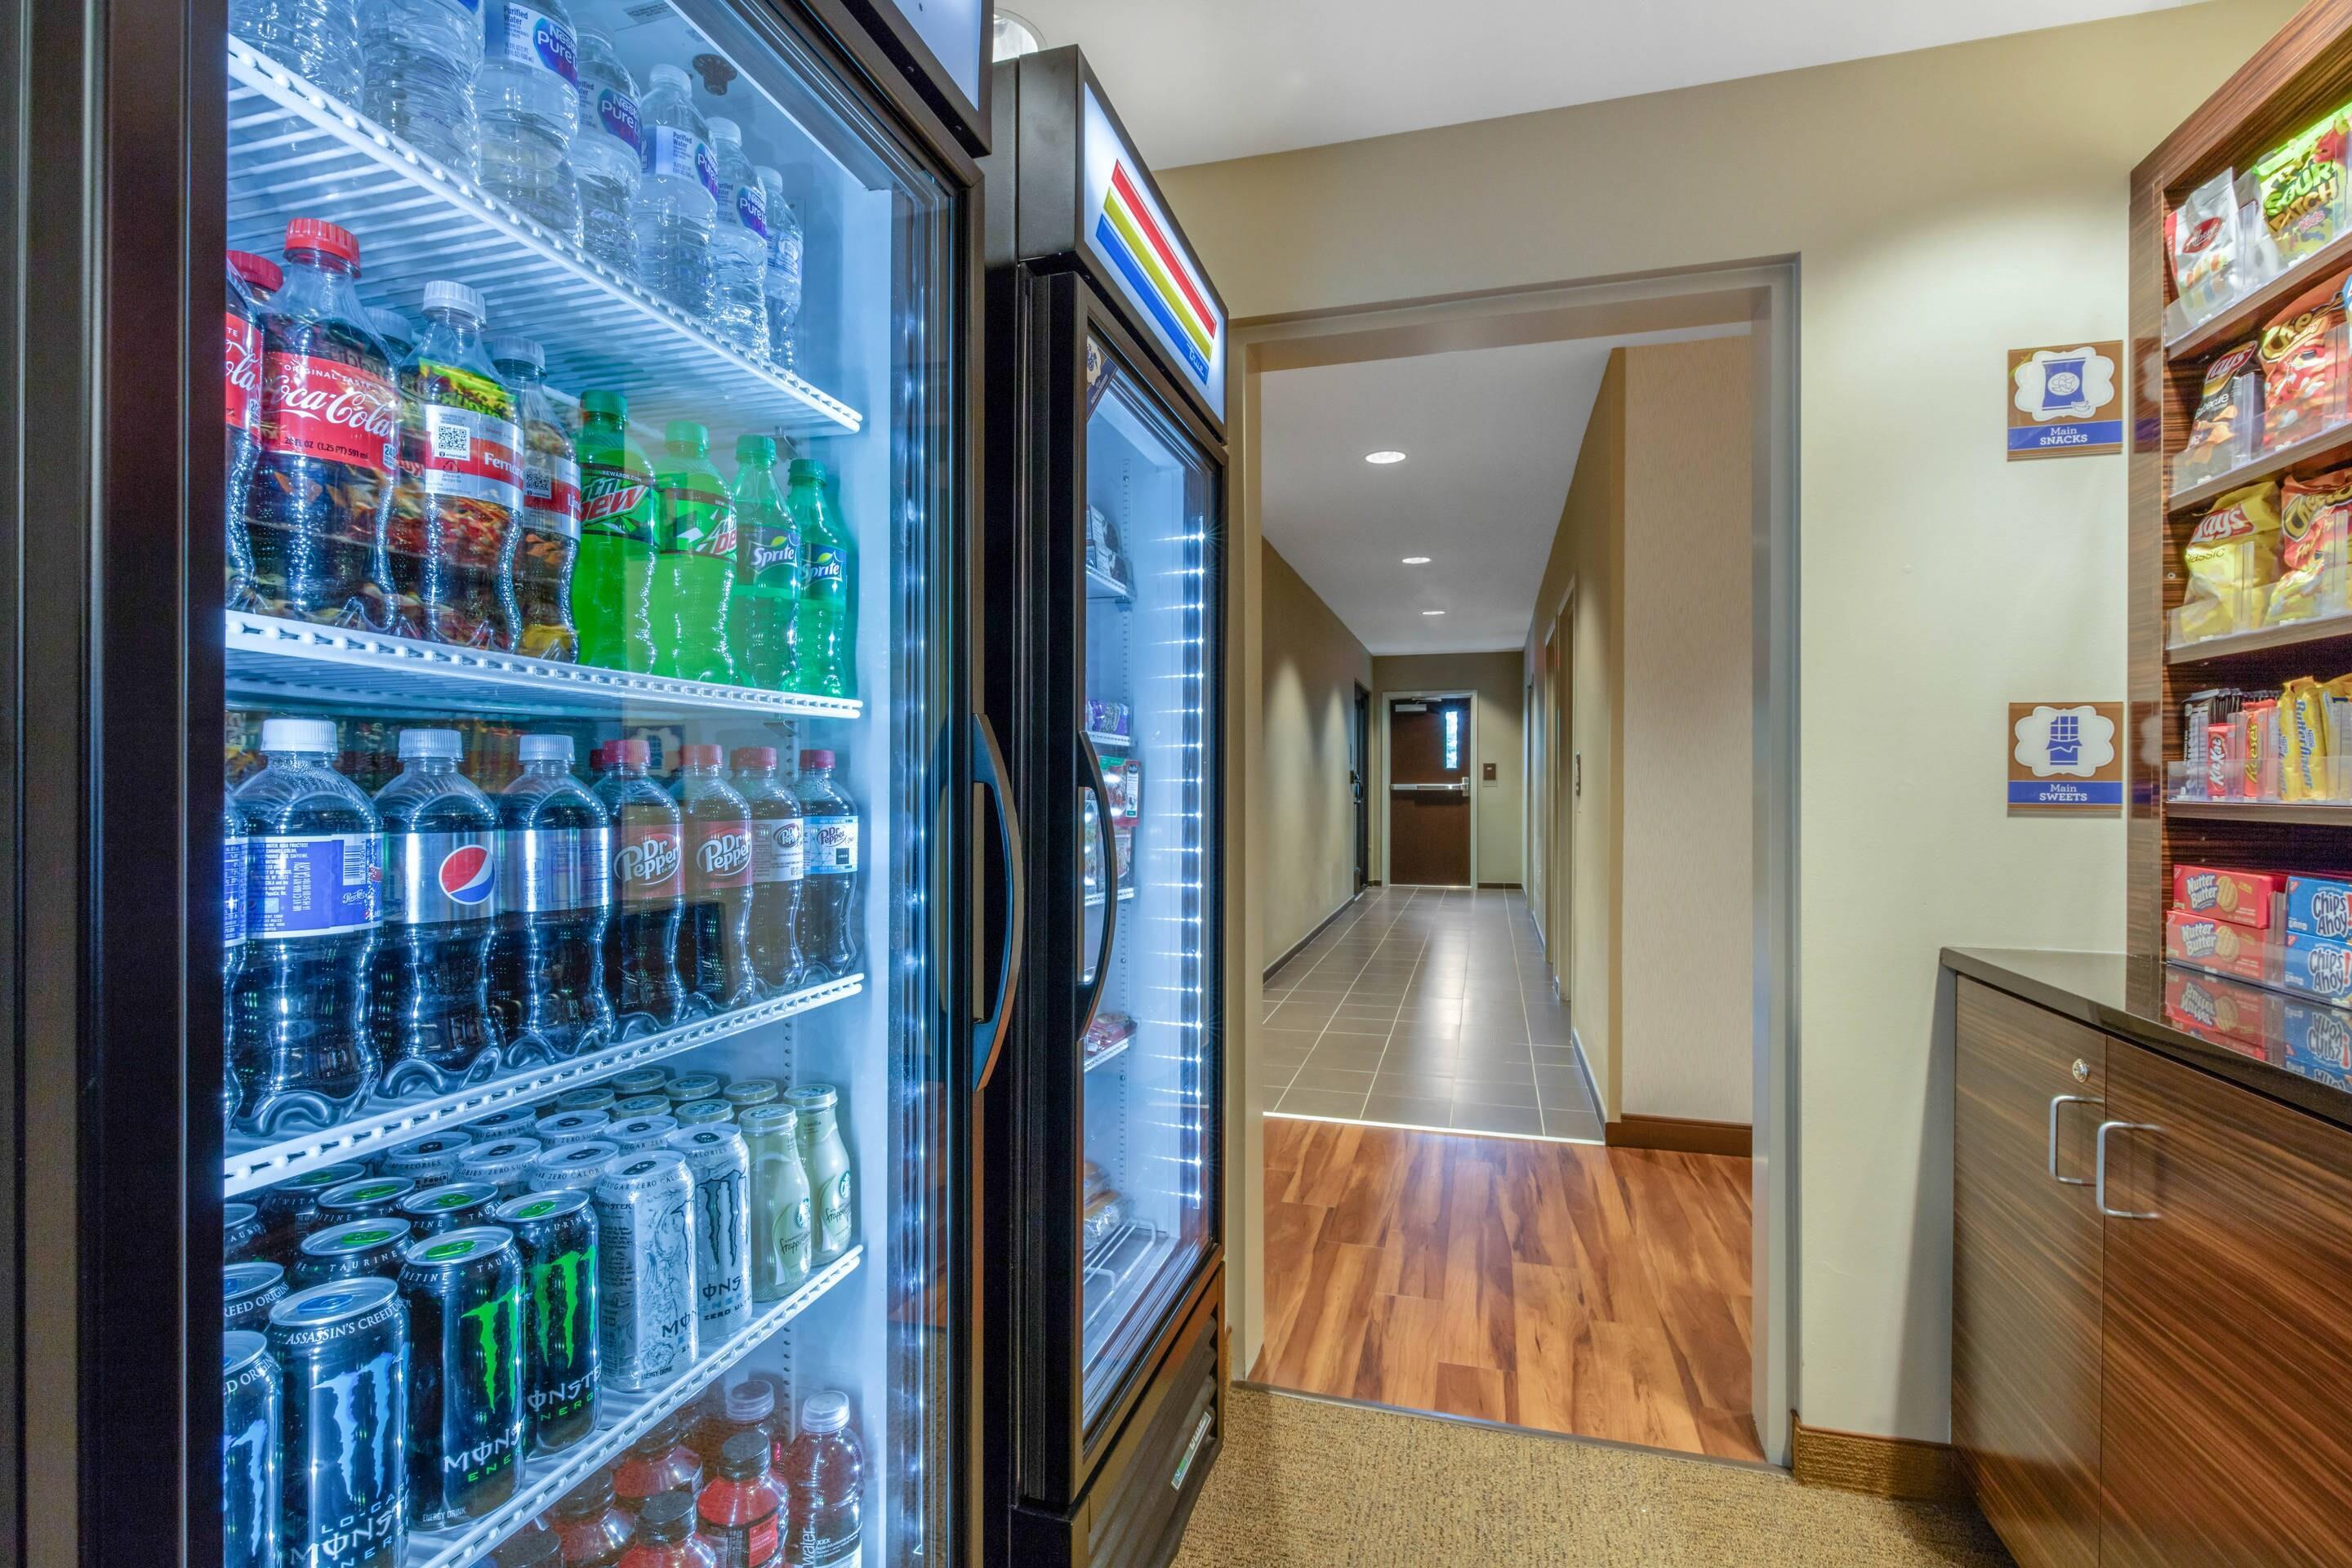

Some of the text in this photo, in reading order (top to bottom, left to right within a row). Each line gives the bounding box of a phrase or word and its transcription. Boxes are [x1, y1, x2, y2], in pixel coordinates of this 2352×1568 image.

[503, 5, 528, 20] Purified
[503, 13, 522, 25] Water
[537, 30, 572, 65] Pure
[579, 82, 595, 91] rified
[602, 100, 634, 129] Pure
[673, 131, 693, 145] Purified
[673, 139, 688, 149] Water
[718, 183, 733, 191] urified
[2264, 159, 2333, 216] SOUR
[2269, 174, 2339, 232] PATCH
[270, 375, 393, 438] Coca-Cola
[2039, 434, 2088, 446] SNACKS
[2051, 426, 2078, 436] Main
[305, 440, 314, 448] OZ
[349, 449, 359, 457] 591
[385, 445, 396, 458] 240
[2192, 508, 2245, 543] Lay's
[751, 544, 794, 568] Sprite
[801, 562, 840, 581] Sprite
[2051, 783, 2078, 792] Main
[2039, 793, 2088, 802] SWEETS
[820, 830, 845, 845] Pepper
[829, 826, 840, 835] Dr
[643, 840, 667, 861] Dr
[722, 834, 740, 854] Dr
[618, 845, 679, 882] Pepper
[704, 840, 751, 873] Pepper
[2186, 874, 2216, 894] Nutter
[2190, 887, 2218, 909] Butter
[2312, 892, 2346, 918] Chips
[2181, 923, 2215, 942] Nutter
[2186, 935, 2217, 956] Butter
[2309, 948, 2344, 974] Chips
[488, 1167, 510, 1176] ZERO
[549, 1173, 567, 1181] ZERO
[607, 1182, 630, 1191] SUGAR
[635, 1180, 657, 1189] ZERO
[535, 1213, 589, 1236] TAURINE
[329, 1250, 399, 1272] TAURINE
[225, 1302, 253, 1318] REED
[704, 1310, 731, 1321] ZERO
[286, 1321, 356, 1345] ASSASSIN'S
[359, 1304, 393, 1330] CREED
[527, 1359, 602, 1412] ONSTE
[422, 1507, 466, 1522] ENERGY DRINK
